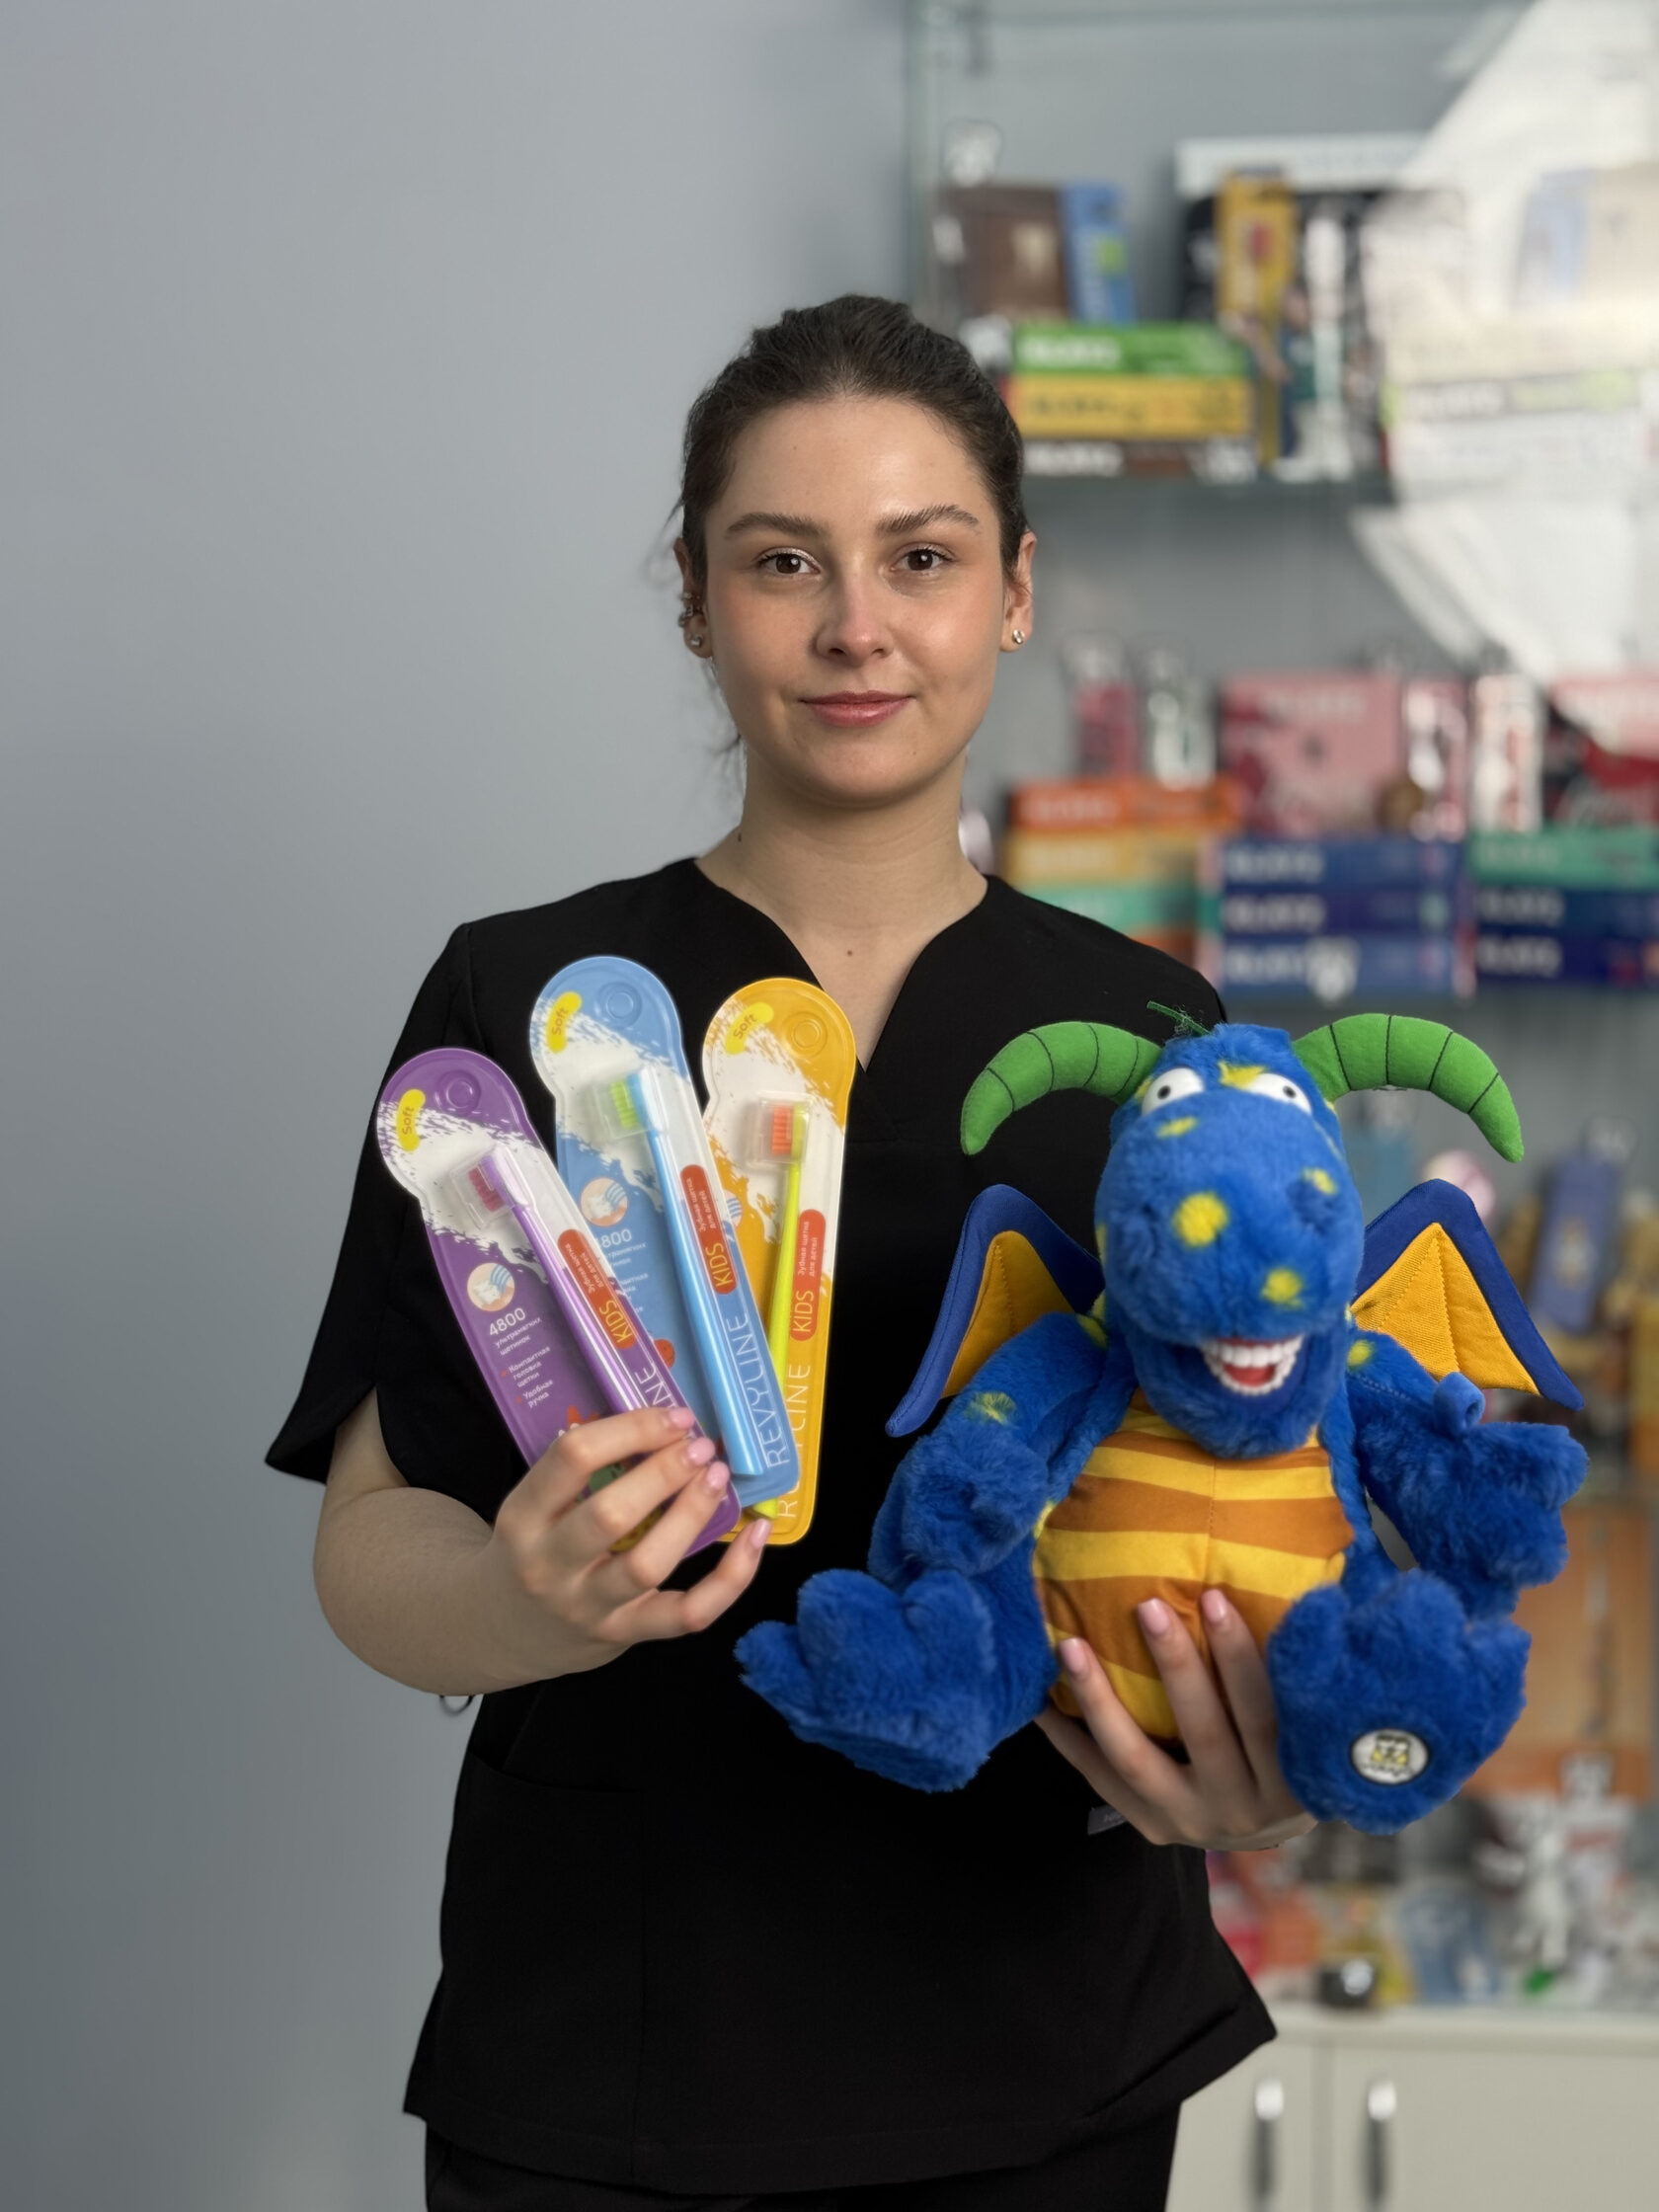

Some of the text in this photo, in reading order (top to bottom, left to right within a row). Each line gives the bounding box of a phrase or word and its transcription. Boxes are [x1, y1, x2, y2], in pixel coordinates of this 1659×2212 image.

[551, 1007, 570, 1036] Soft
[733, 1013, 758, 1040] Soft
[402, 1106, 416, 1136] Soft
[595, 1228, 632, 1248] 800
[810, 1237, 819, 1260] детей
[705, 1242, 734, 1287] KIDS
[798, 1247, 808, 1277] Зубная
[489, 1307, 526, 1336] 4800
[598, 1300, 633, 1343] KIDS
[792, 1290, 815, 1333] KIDS
[508, 1345, 551, 1374] Компактная
[513, 1361, 543, 1381] головка
[516, 1372, 541, 1388] щетки
[522, 1379, 554, 1399] Удобная
[726, 1312, 790, 1469] REVYLINE
[527, 1391, 550, 1409] ручка
